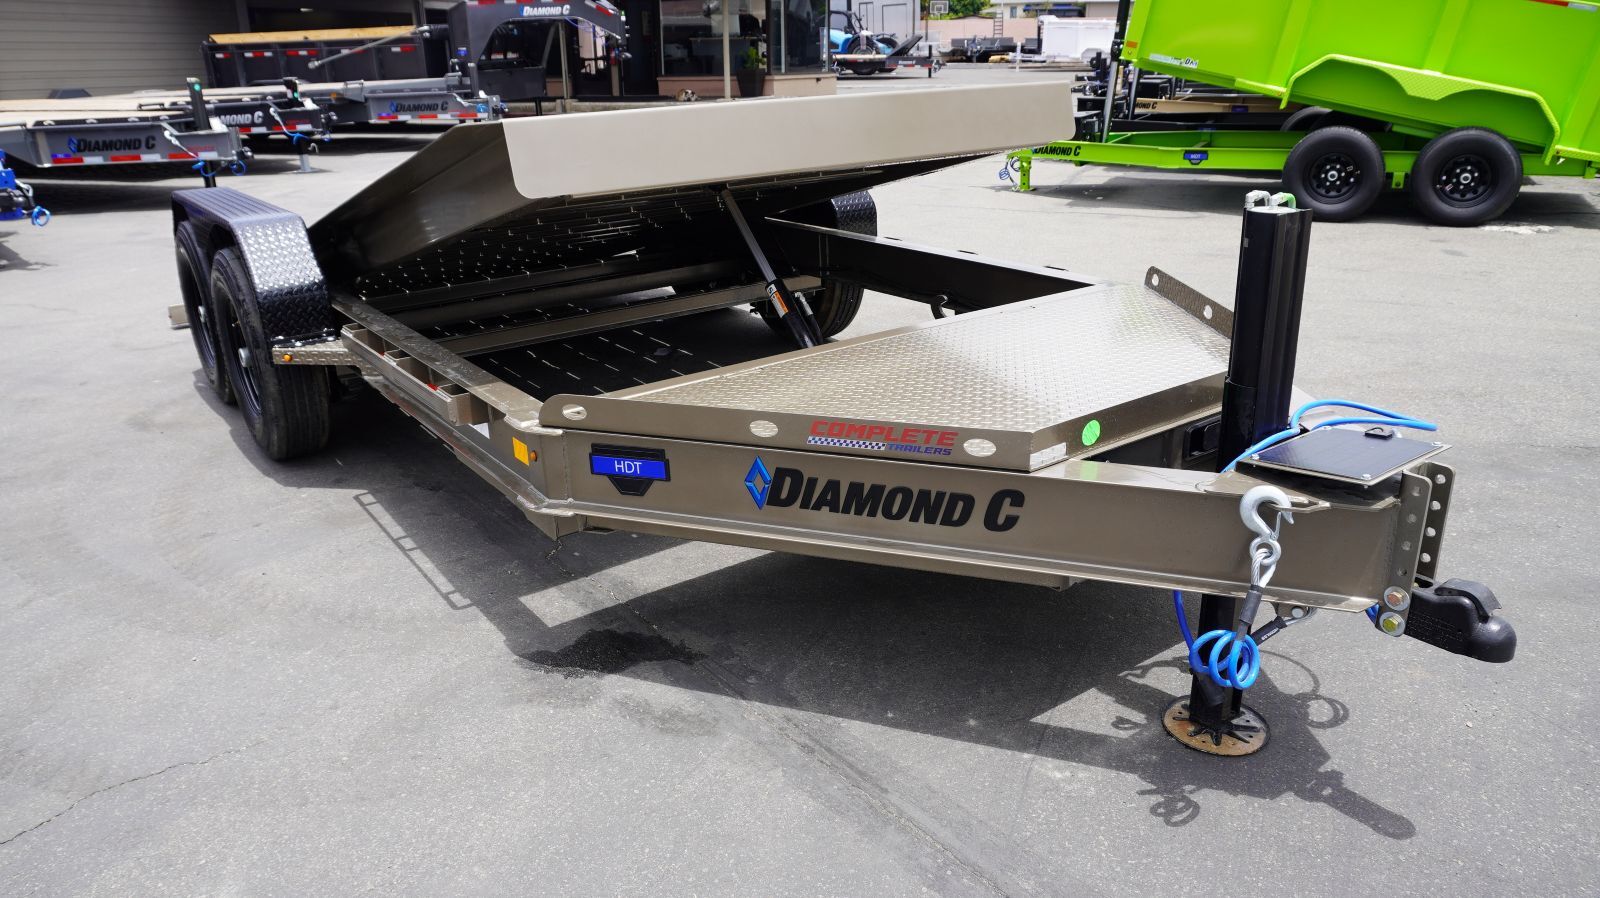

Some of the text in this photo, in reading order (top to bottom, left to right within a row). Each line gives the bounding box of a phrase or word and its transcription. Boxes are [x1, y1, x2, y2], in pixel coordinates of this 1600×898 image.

[523, 4, 571, 16] DIAMOND C
[396, 103, 439, 112] DIAMOND
[440, 101, 449, 111] C
[253, 110, 264, 124] C
[77, 135, 156, 153] DIAMOND C
[1073, 145, 1082, 157] C
[810, 419, 959, 447] COMPLETE
[888, 443, 952, 456] TRAILERS
[614, 460, 642, 475] HDT
[766, 466, 1026, 532] DIAMOND C
